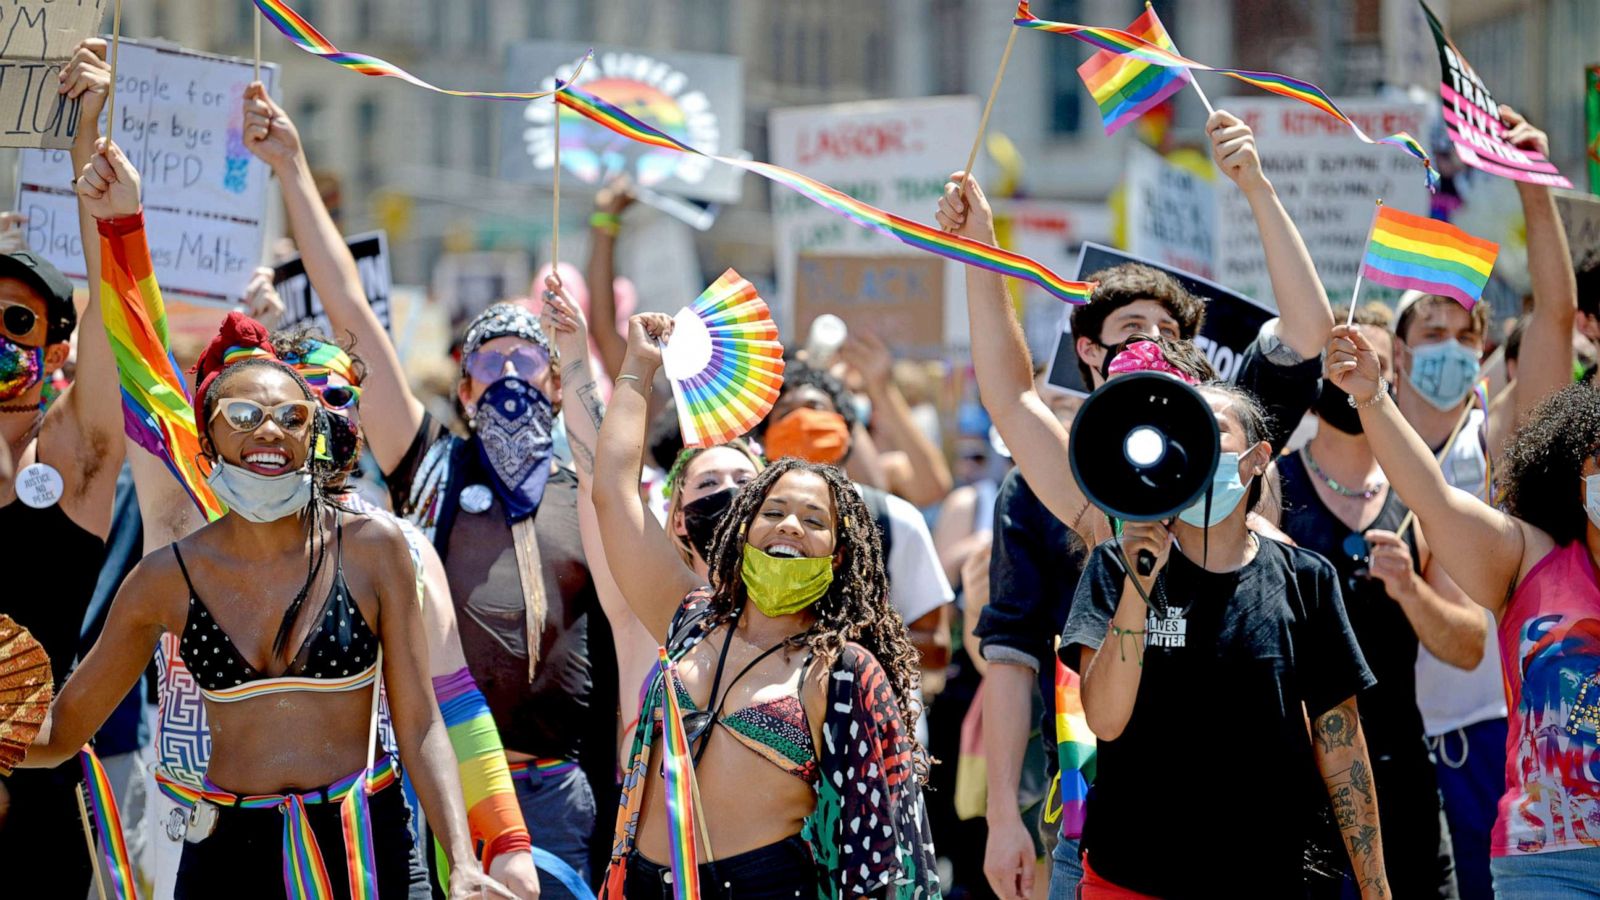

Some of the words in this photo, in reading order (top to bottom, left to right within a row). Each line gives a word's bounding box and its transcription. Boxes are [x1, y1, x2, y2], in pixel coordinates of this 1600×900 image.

[115, 75, 170, 103] eople
[186, 80, 224, 106] for
[1449, 67, 1500, 120] TRAN
[122, 105, 159, 142] bye
[171, 113, 213, 150] bye
[1453, 94, 1512, 147] LIVE
[28, 204, 81, 257] Blac
[174, 231, 247, 274] Matter
[1150, 619, 1179, 632] LIVES
